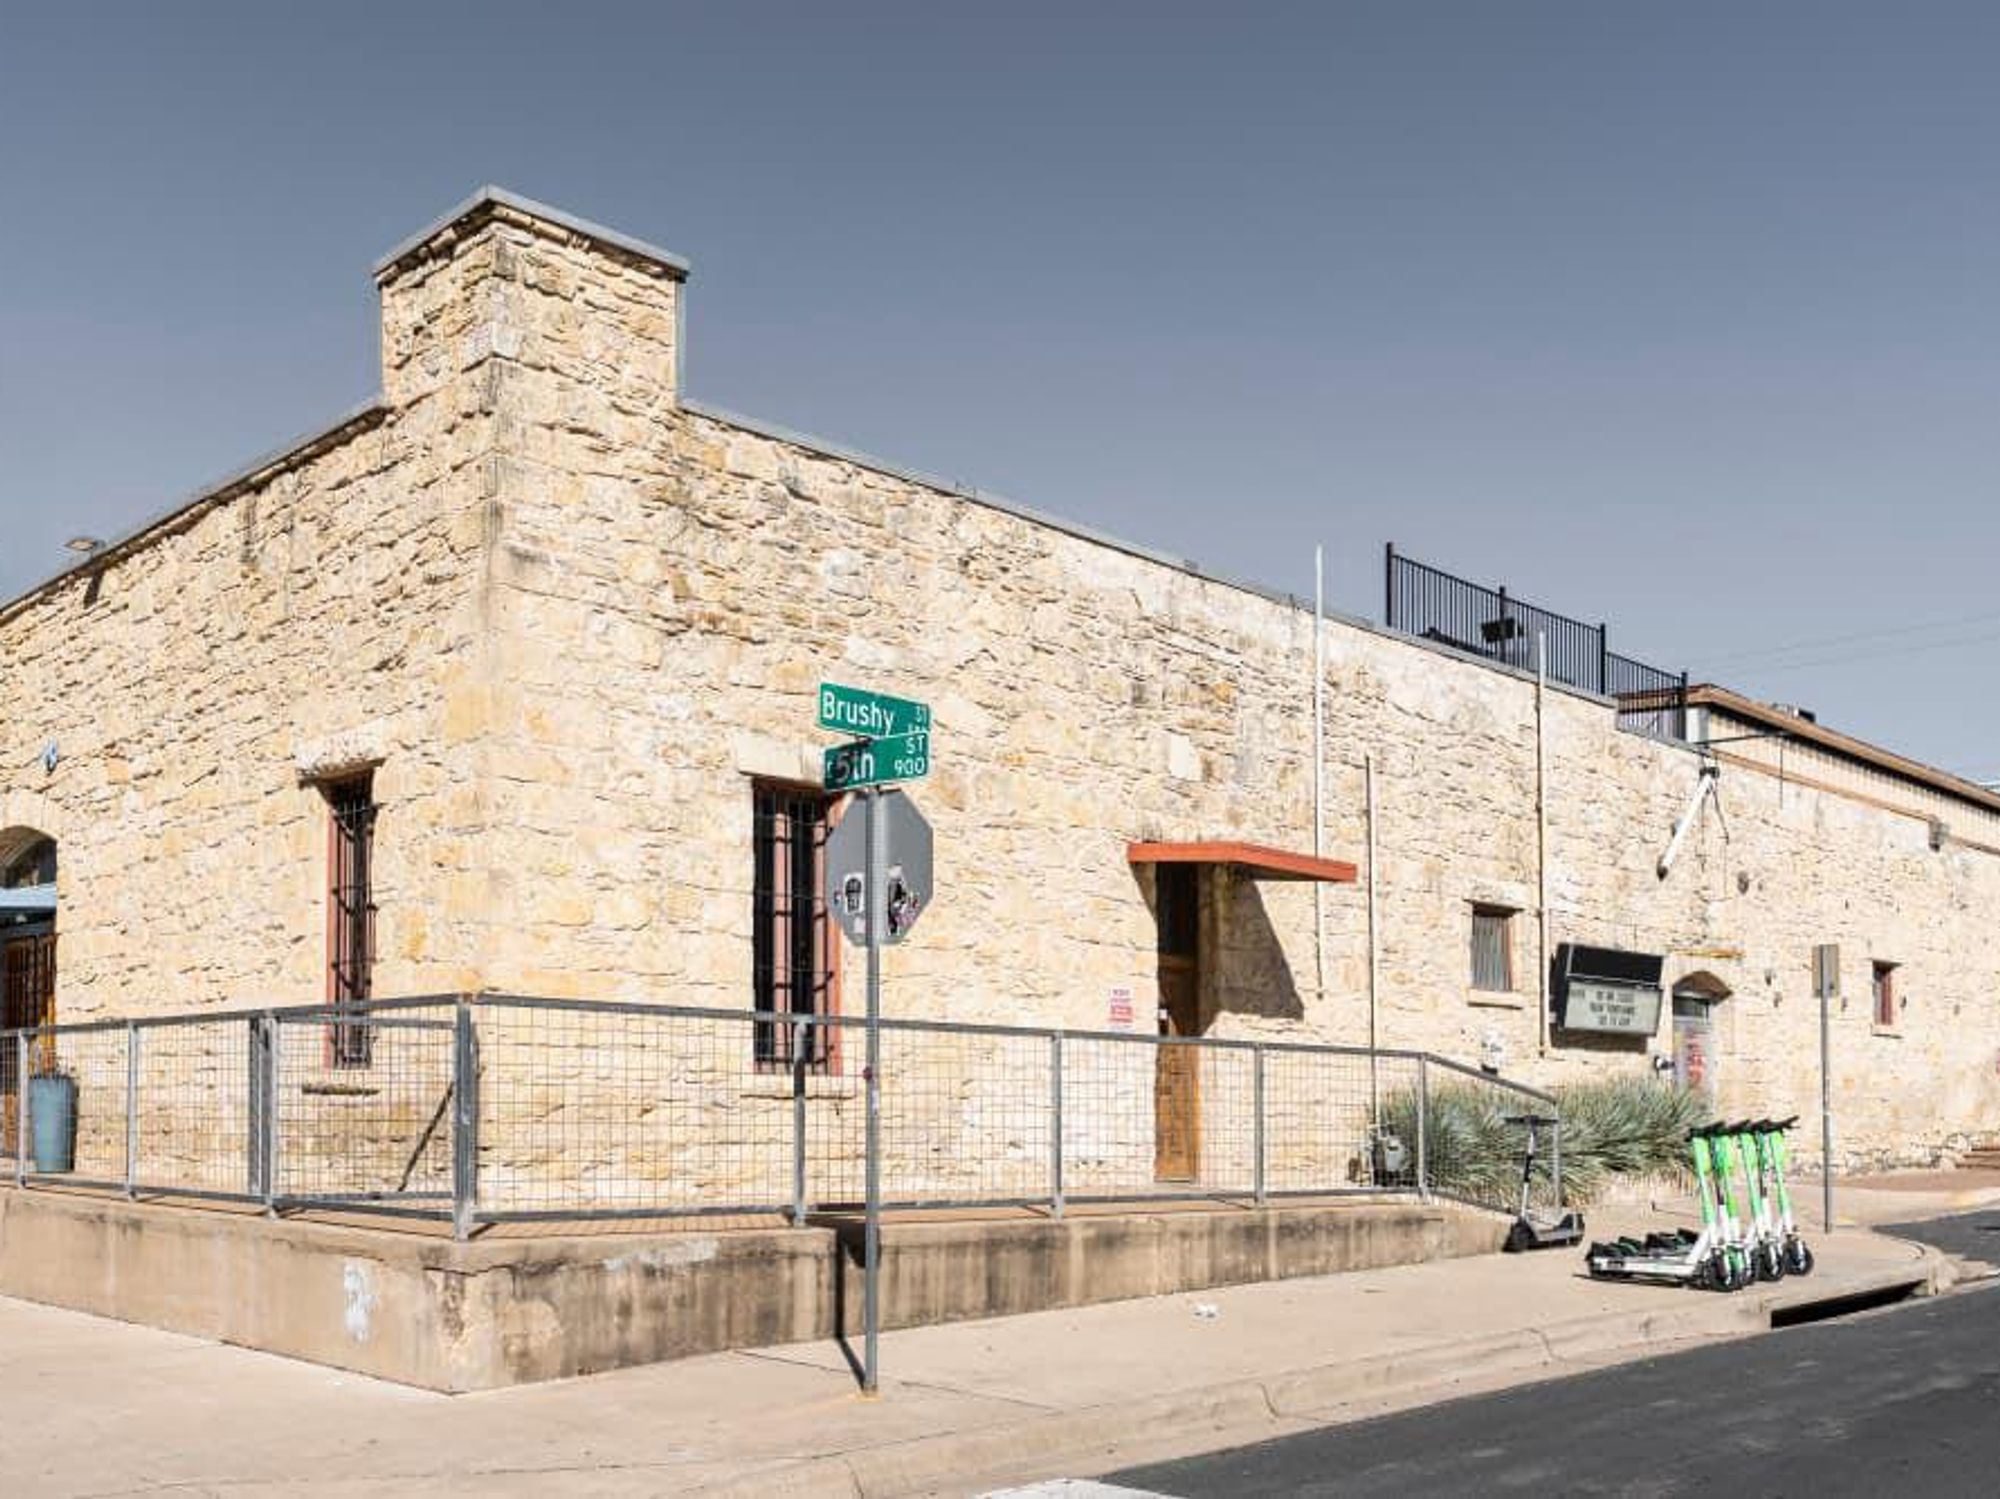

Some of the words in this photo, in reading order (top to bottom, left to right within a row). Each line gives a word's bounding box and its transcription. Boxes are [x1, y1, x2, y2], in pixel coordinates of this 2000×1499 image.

[822, 691, 894, 737] Brushy
[905, 735, 926, 755] ST
[894, 756, 926, 776] 900
